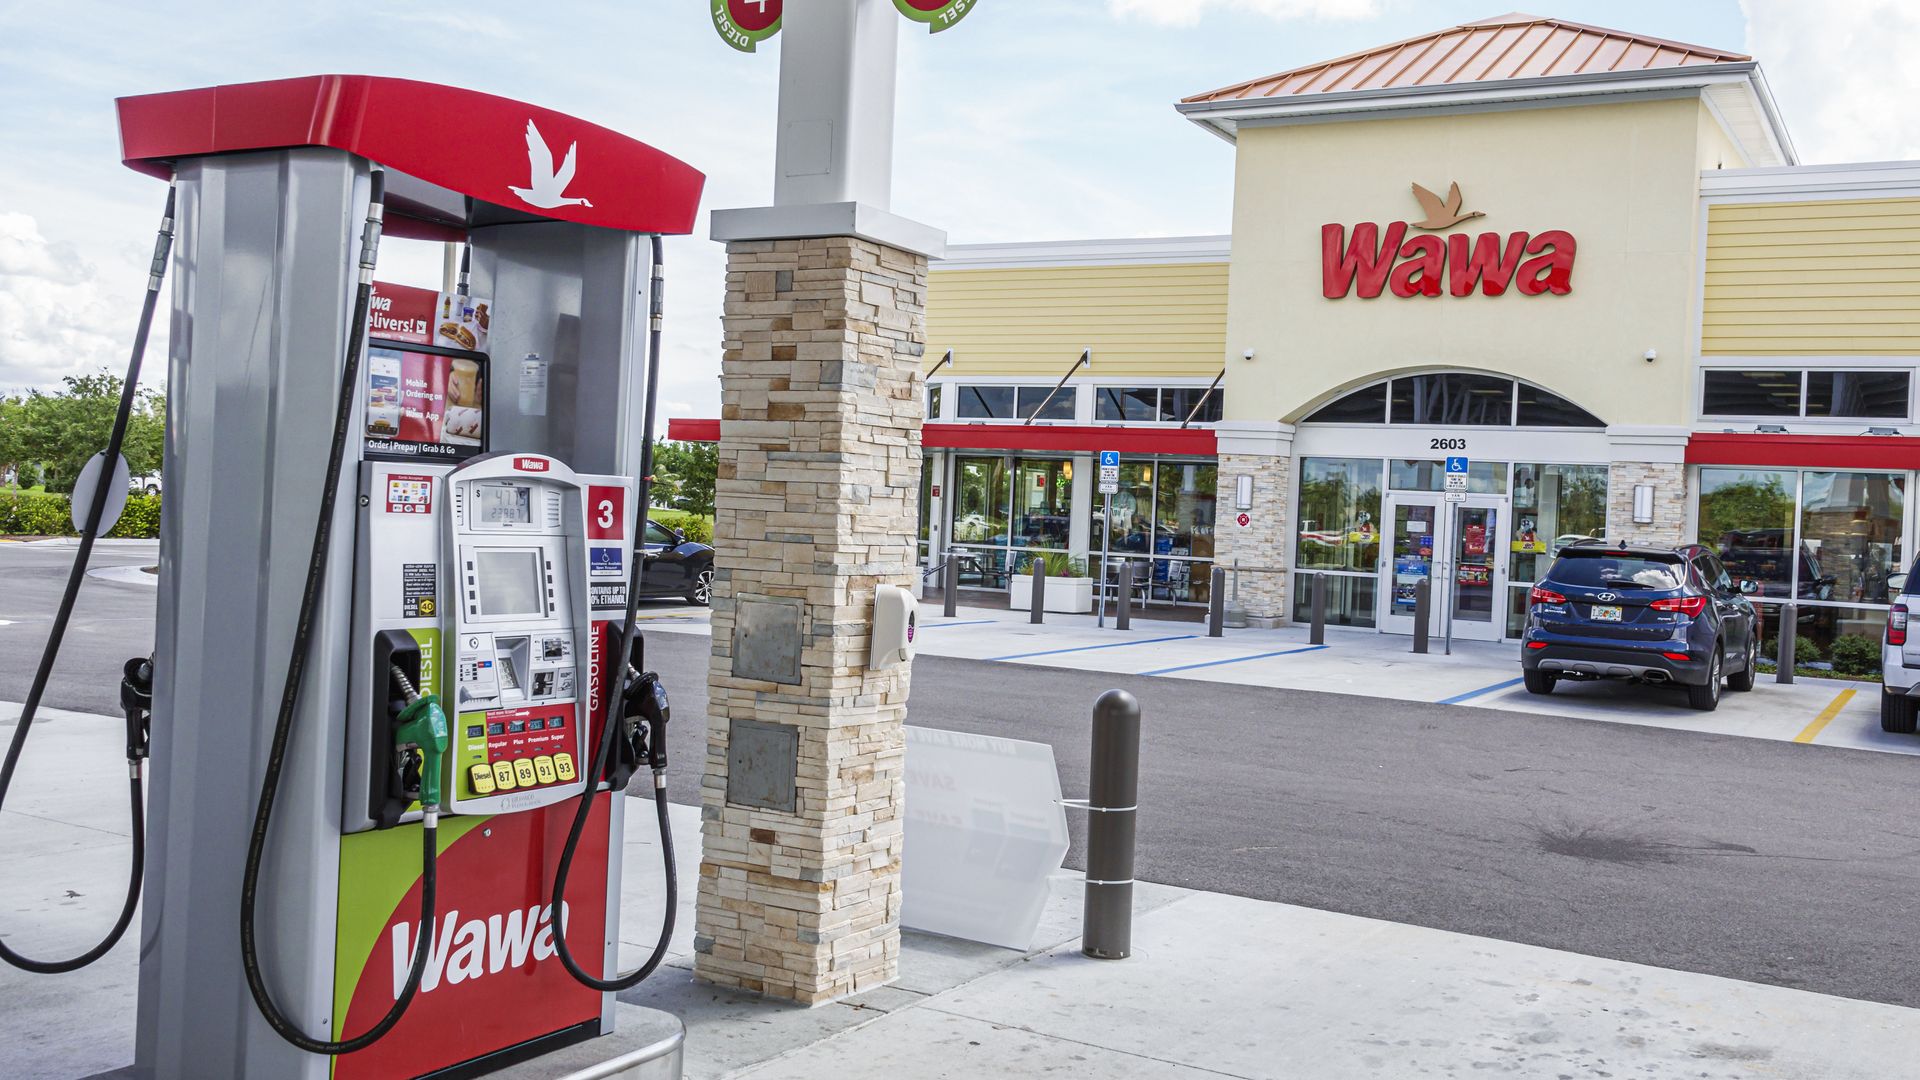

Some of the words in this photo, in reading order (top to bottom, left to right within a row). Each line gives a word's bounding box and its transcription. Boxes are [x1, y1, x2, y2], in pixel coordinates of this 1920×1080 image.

[938, 0, 972, 24] SEL
[715, 4, 749, 47] DIESEL
[1321, 220, 1577, 299] Wawa
[369, 295, 392, 311] wa
[368, 312, 414, 333] elivers!
[405, 379, 428, 388] Mobile
[405, 390, 434, 401] Ordering
[425, 411, 440, 421] App
[368, 440, 389, 449] Order
[394, 442, 418, 453] Prepay
[422, 444, 439, 453] Grab
[446, 446, 456, 454] Go
[1430, 438, 1466, 450] 2603
[521, 458, 544, 470] Wawa
[476, 489, 481, 498] $
[597, 499, 614, 529] 3
[612, 586, 619, 595] UP
[619, 586, 626, 595] TO
[600, 594, 626, 605] ETHANOL
[421, 602, 433, 611] 40
[420, 637, 433, 697] DIESEL
[590, 625, 599, 712] GASOLINE
[467, 743, 485, 751] Diesel
[488, 741, 508, 749] Regular
[539, 765, 552, 776] 91
[559, 762, 571, 773] 93
[474, 771, 492, 780] Diesel
[498, 771, 510, 782] 87
[520, 768, 532, 779] 89
[392, 900, 570, 1000] Wawa
